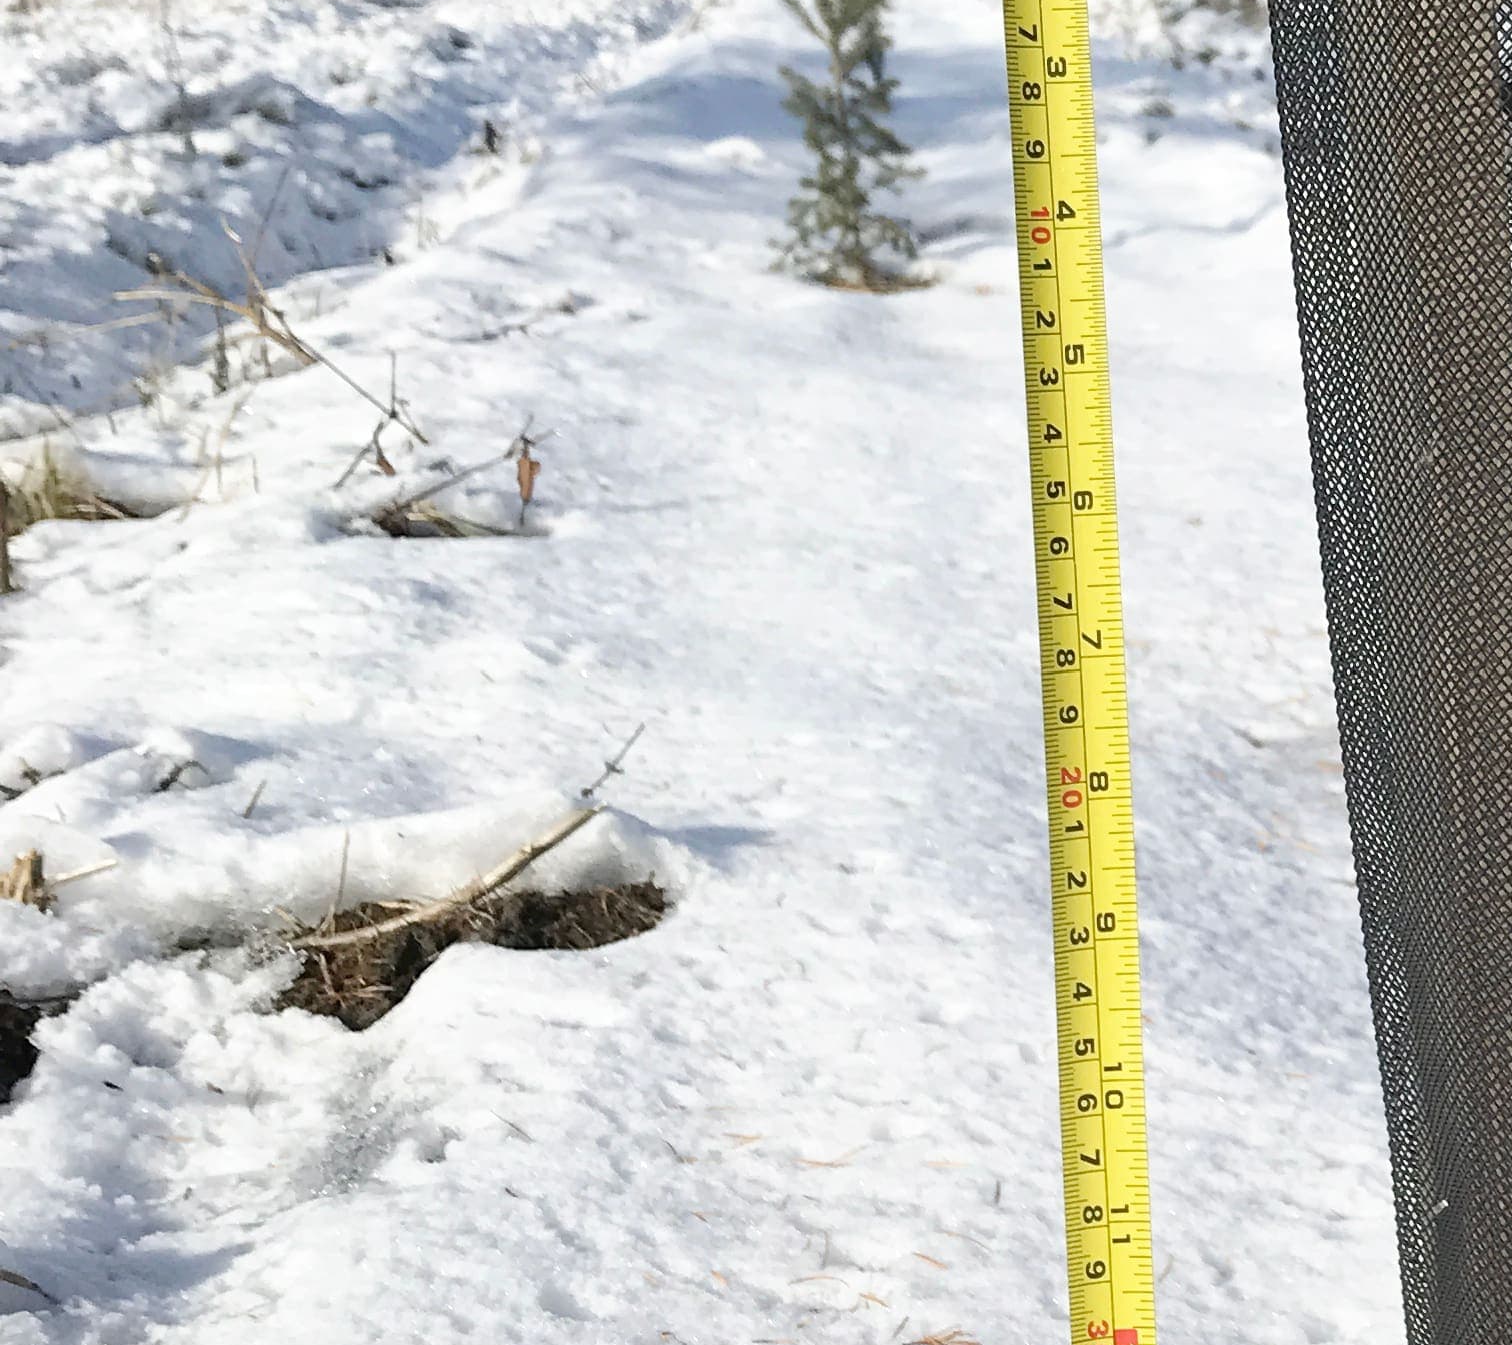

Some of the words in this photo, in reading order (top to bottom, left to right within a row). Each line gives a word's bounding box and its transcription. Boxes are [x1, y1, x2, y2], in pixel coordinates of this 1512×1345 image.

[1018, 23, 1038, 42] 7
[1046, 56, 1067, 78] 3
[1022, 81, 1042, 101] 8
[1025, 139, 1045, 159] 9
[1055, 200, 1077, 222] 4
[1032, 258, 1053, 271] 1
[1036, 310, 1056, 329] 2
[1064, 343, 1085, 366] 5
[1039, 367, 1060, 386] 3
[1043, 423, 1063, 444] 4
[1046, 480, 1066, 499] 5
[1073, 490, 1094, 511] 6
[1049, 536, 1070, 556] 6
[1053, 592, 1073, 611] 7
[1081, 629, 1102, 650] 7
[1056, 648, 1076, 668] 8
[1059, 705, 1079, 724] 9
[1089, 771, 1109, 792] 8
[1064, 820, 1085, 833] 1
[1067, 870, 1088, 890] 2
[1096, 912, 1116, 933] 9
[1069, 926, 1090, 946] 3
[1072, 981, 1093, 1002] 4
[1074, 1038, 1095, 1057] 5
[1077, 1093, 1098, 1113] 6
[1079, 1148, 1101, 1167] 7
[1082, 1205, 1104, 1224] 8
[1085, 1260, 1106, 1280] 9
